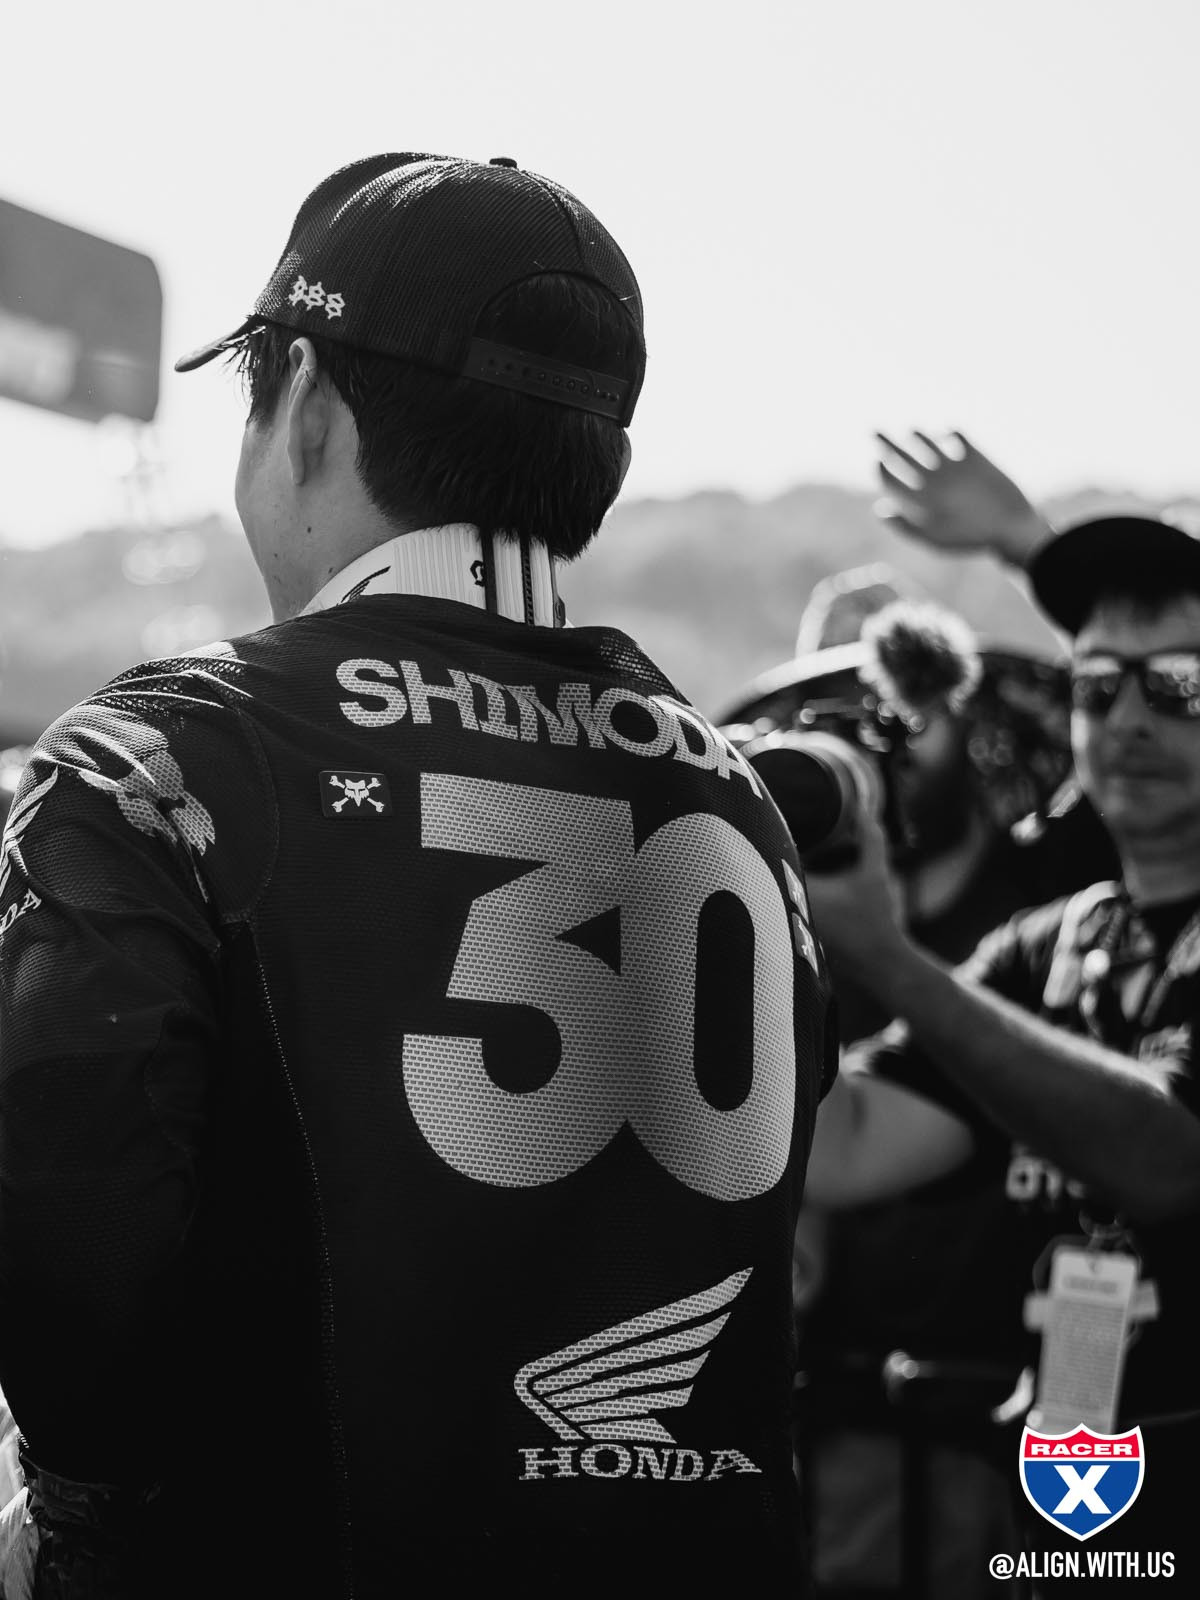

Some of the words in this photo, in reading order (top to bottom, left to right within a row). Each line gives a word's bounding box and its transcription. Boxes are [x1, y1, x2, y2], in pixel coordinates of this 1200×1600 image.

[336, 657, 763, 801] SHIMODA
[402, 771, 797, 1203] 30
[517, 1443, 763, 1482] HONDA
